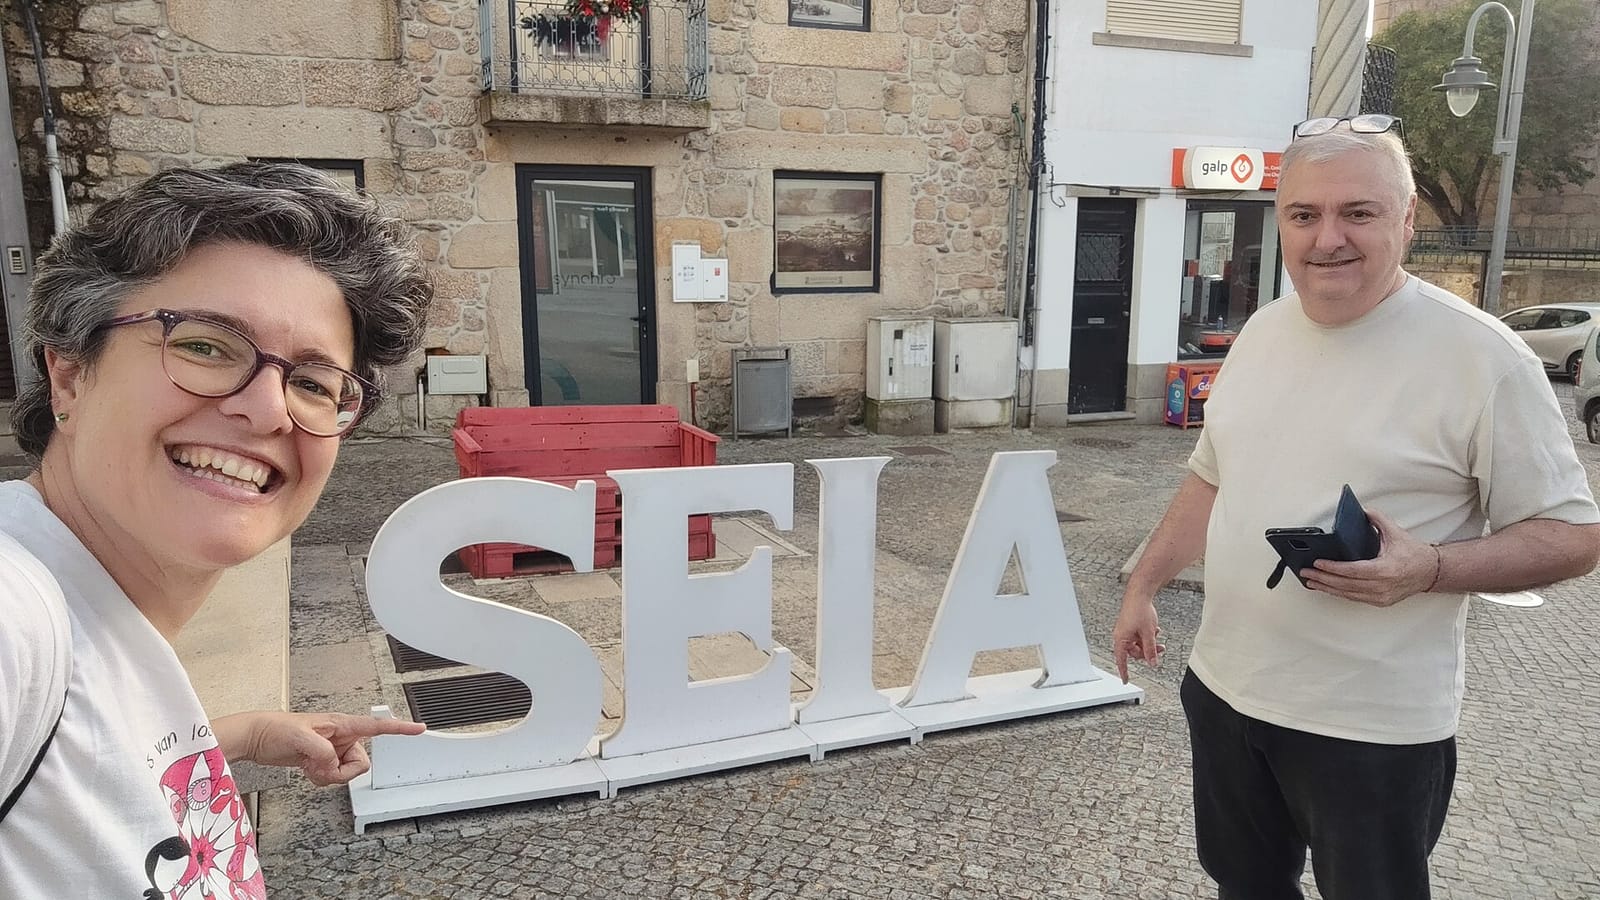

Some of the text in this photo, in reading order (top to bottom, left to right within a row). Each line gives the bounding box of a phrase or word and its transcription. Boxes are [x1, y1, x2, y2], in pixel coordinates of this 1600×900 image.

[1202, 160, 1228, 175] galp
[366, 451, 1102, 789] SEIA
[154, 731, 178, 755] van
